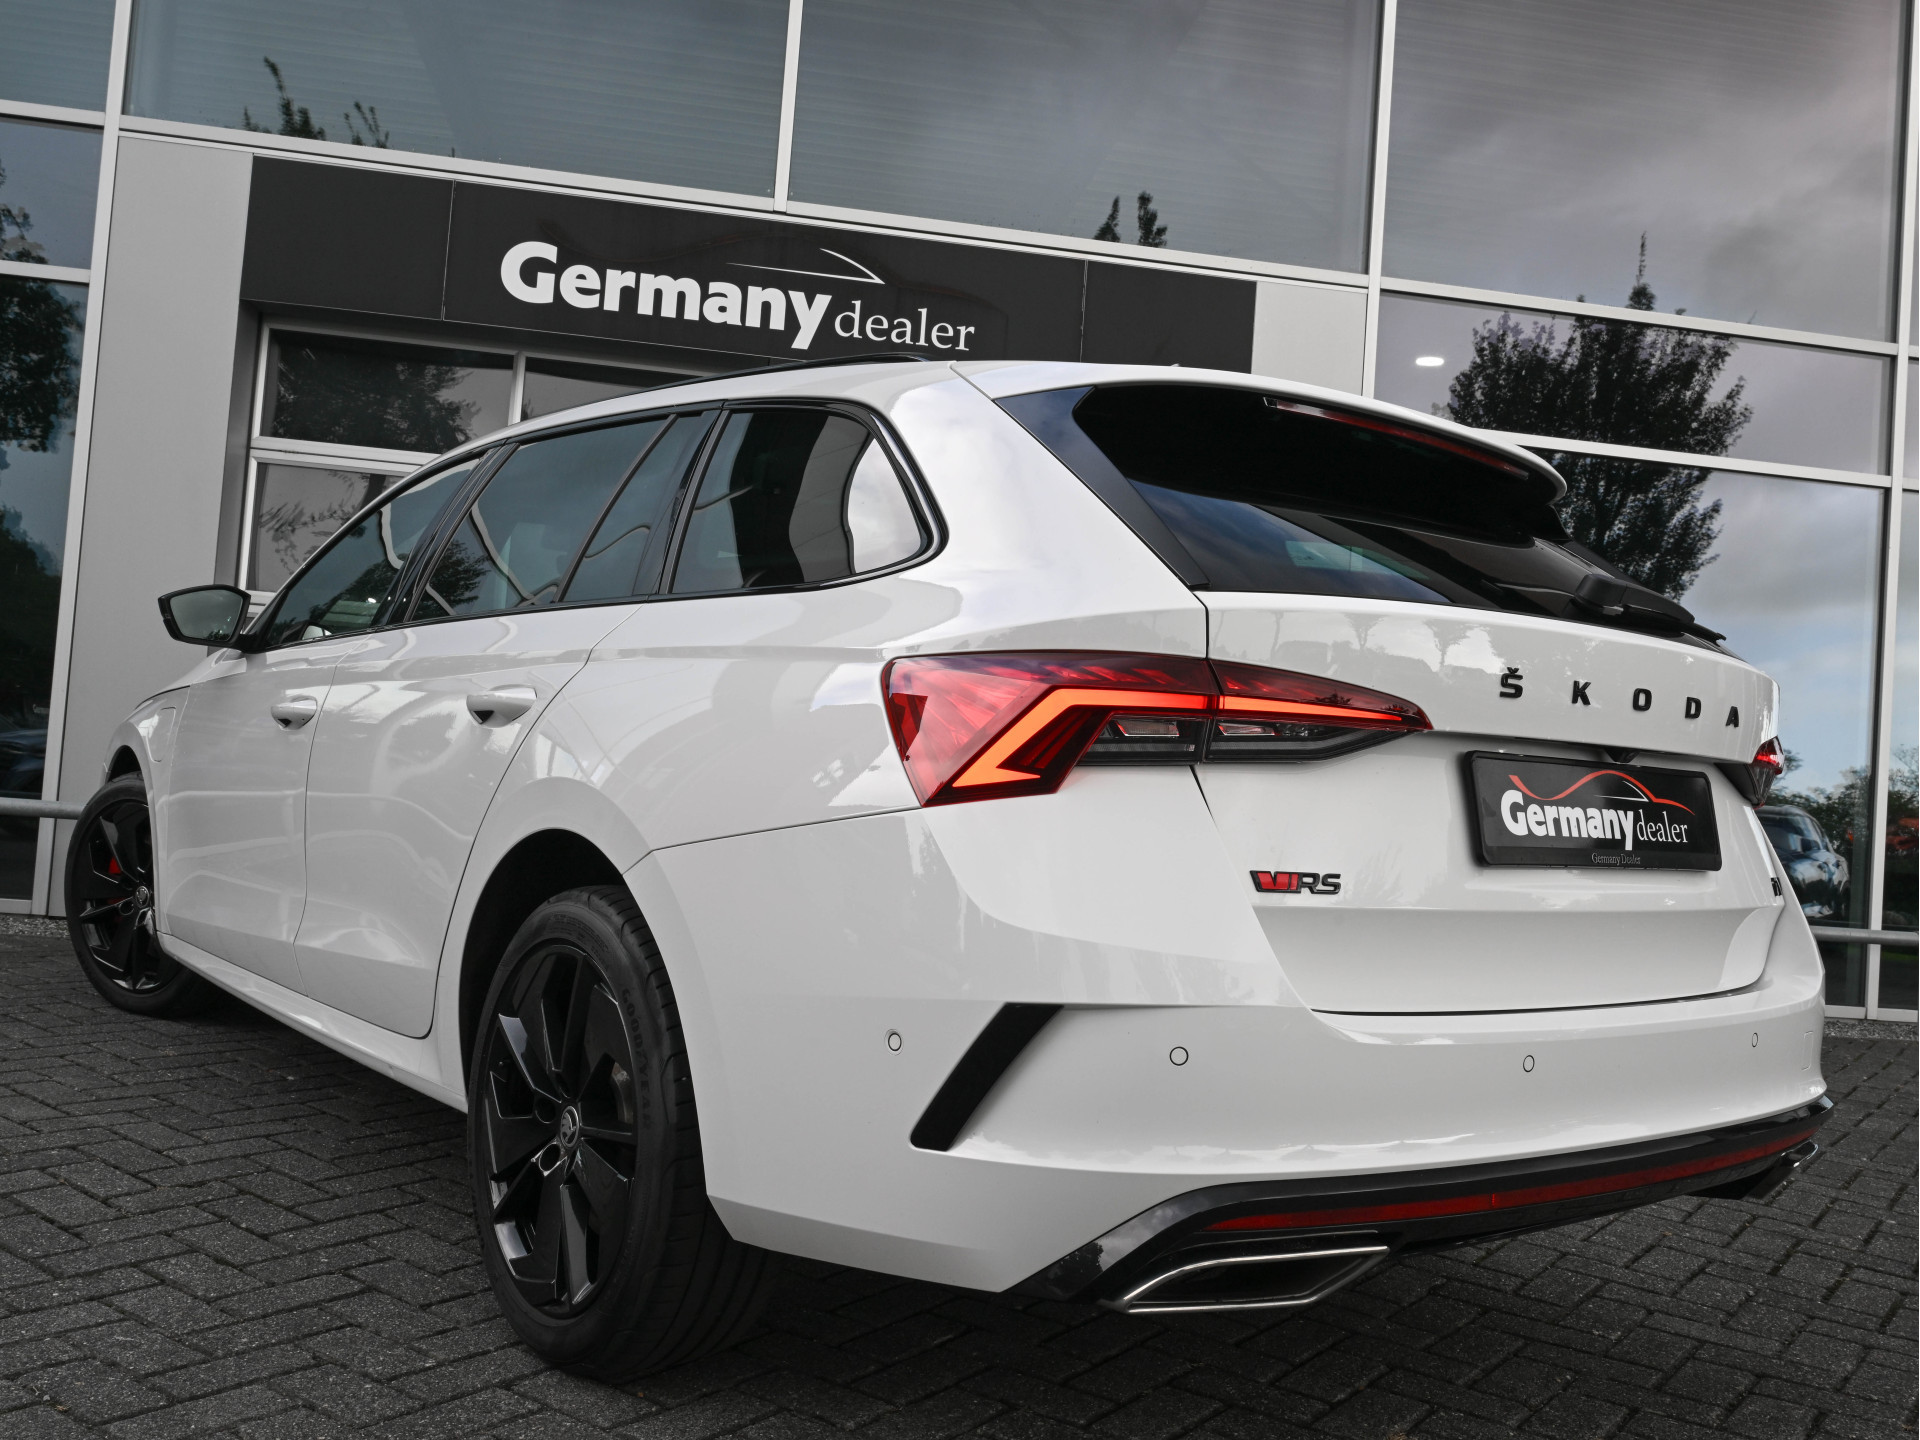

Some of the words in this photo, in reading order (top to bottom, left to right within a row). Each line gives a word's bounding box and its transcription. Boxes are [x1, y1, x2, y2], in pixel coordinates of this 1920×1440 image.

[500, 241, 832, 349] Germany
[834, 300, 975, 351] dealer
[1500, 667, 1740, 728] ŠKODA
[1500, 789, 1634, 850] Germany
[1637, 811, 1688, 843] dealer
[1591, 852, 1620, 866] Germany
